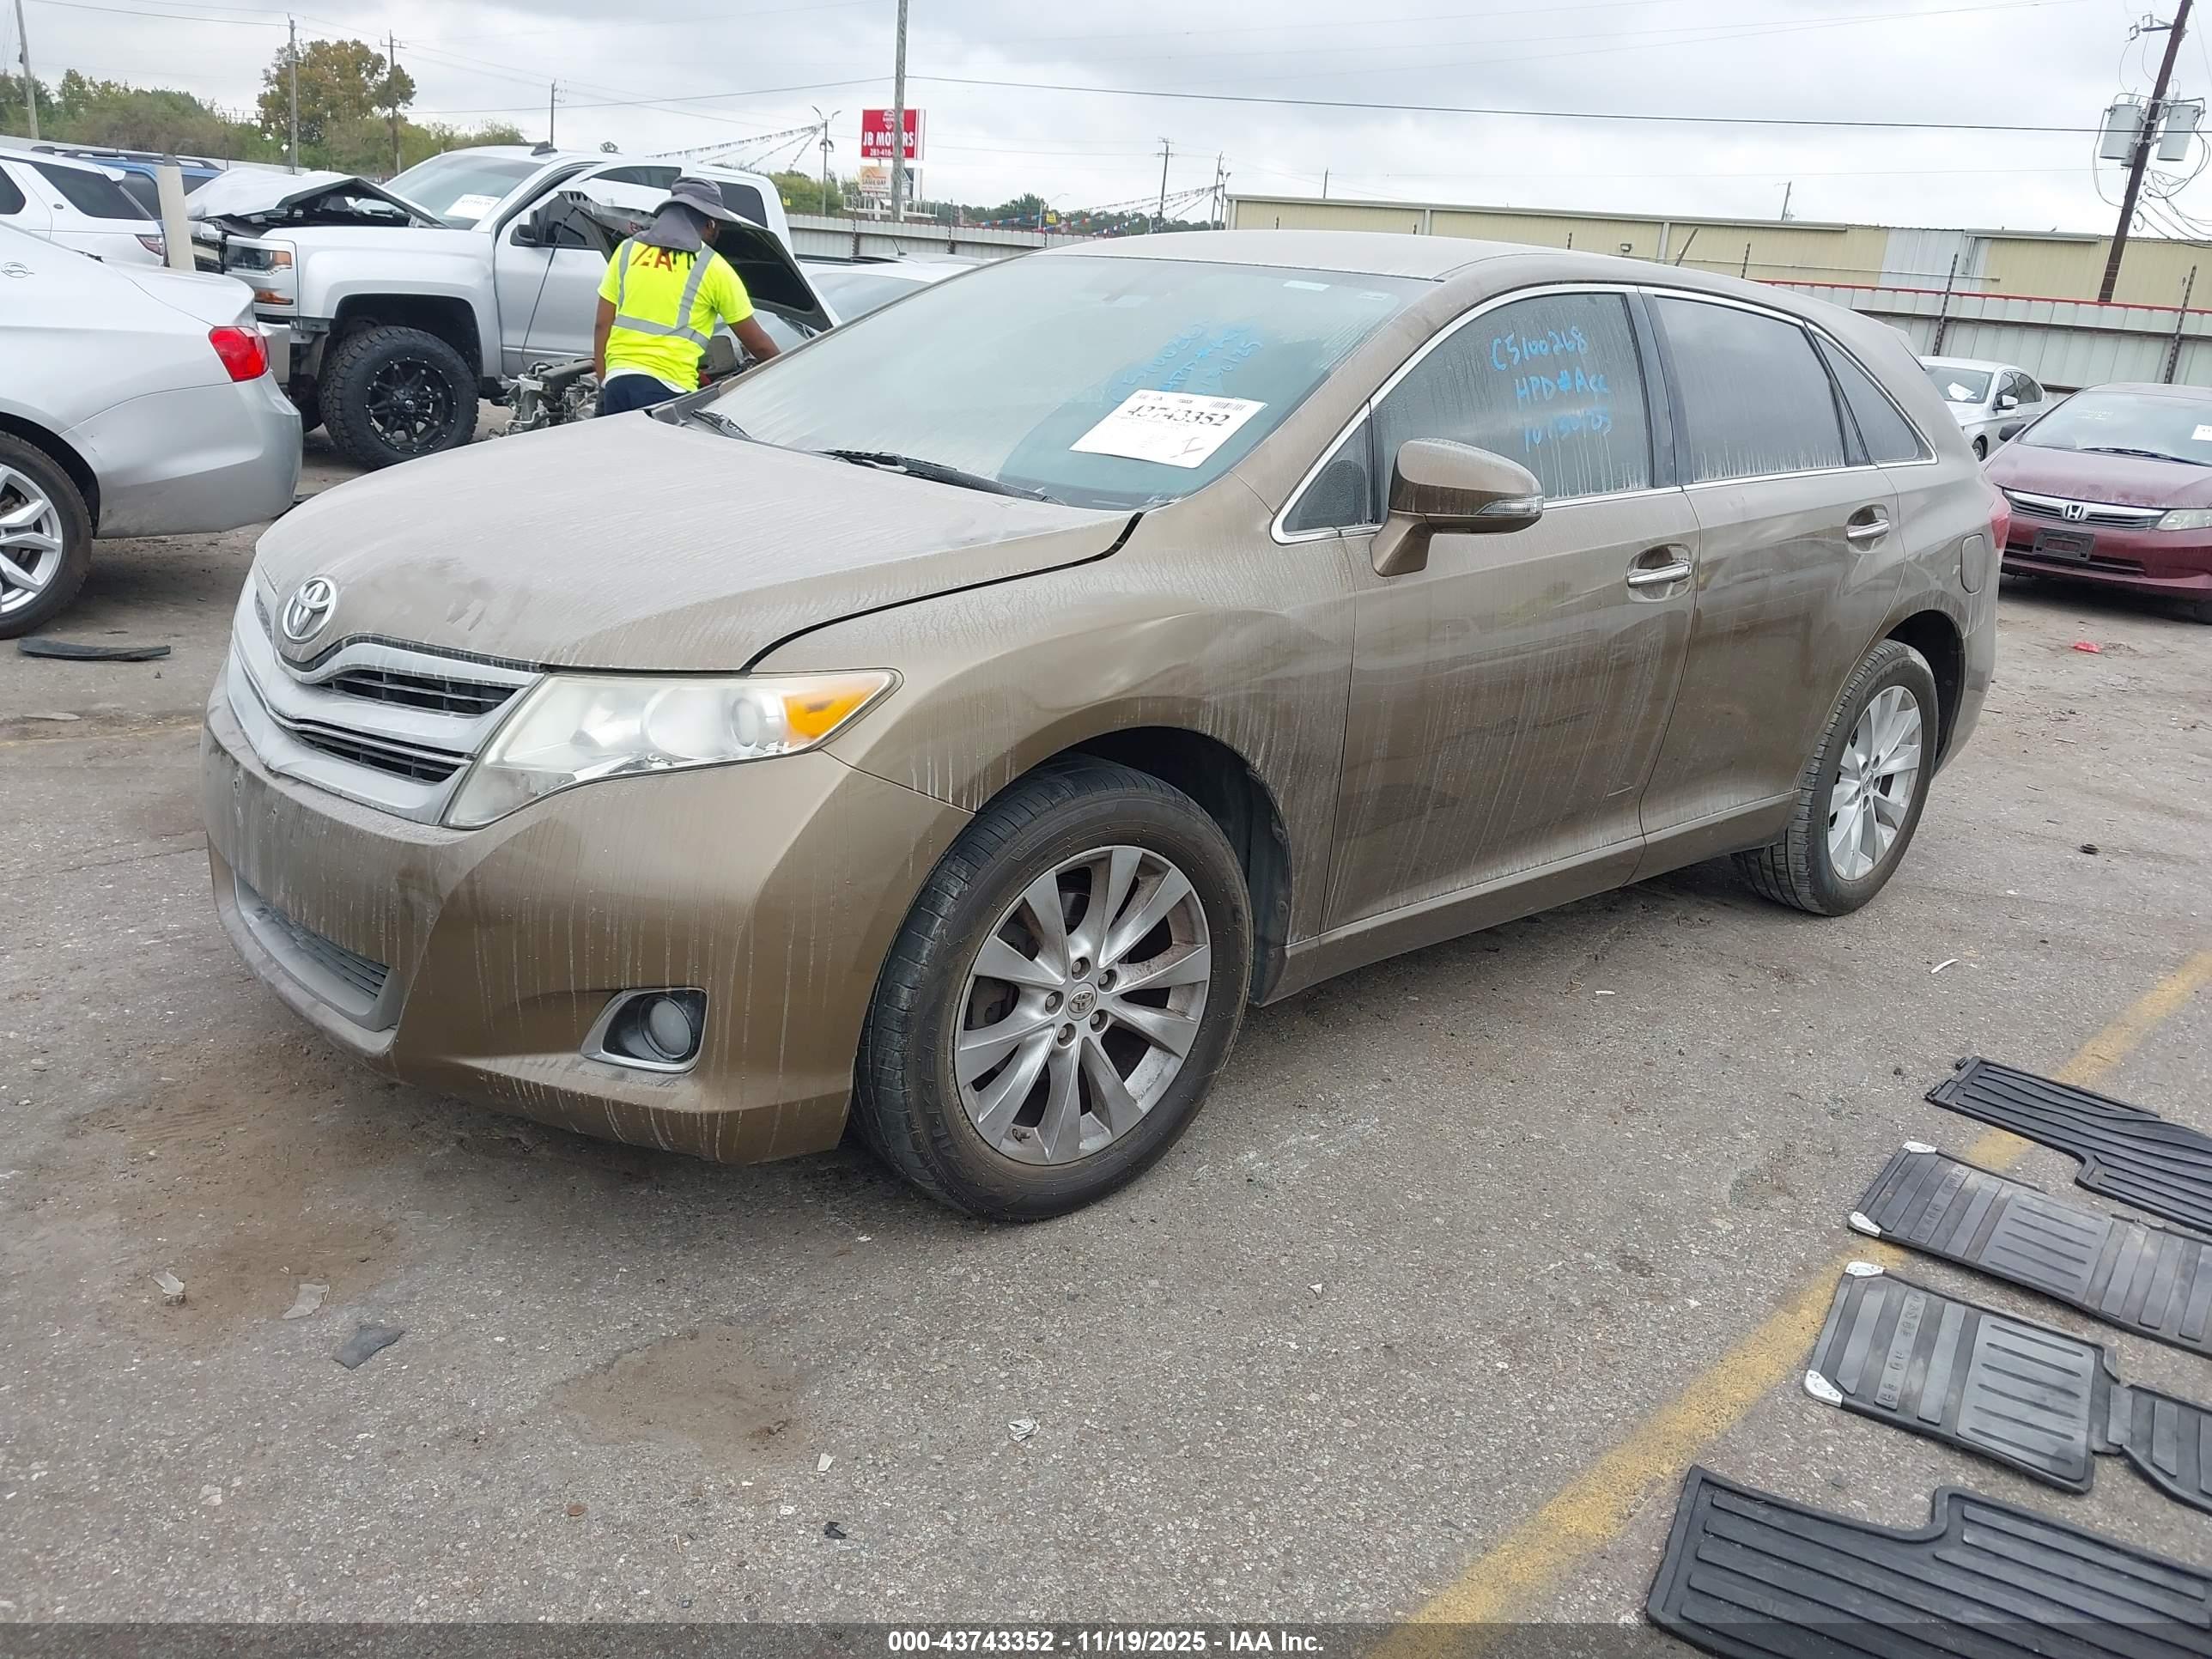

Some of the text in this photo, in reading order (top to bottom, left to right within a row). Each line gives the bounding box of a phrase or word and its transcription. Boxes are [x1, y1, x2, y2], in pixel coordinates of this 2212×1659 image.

[862, 131, 915, 146] JB MORS
[1127, 404, 1231, 427] 43743352
